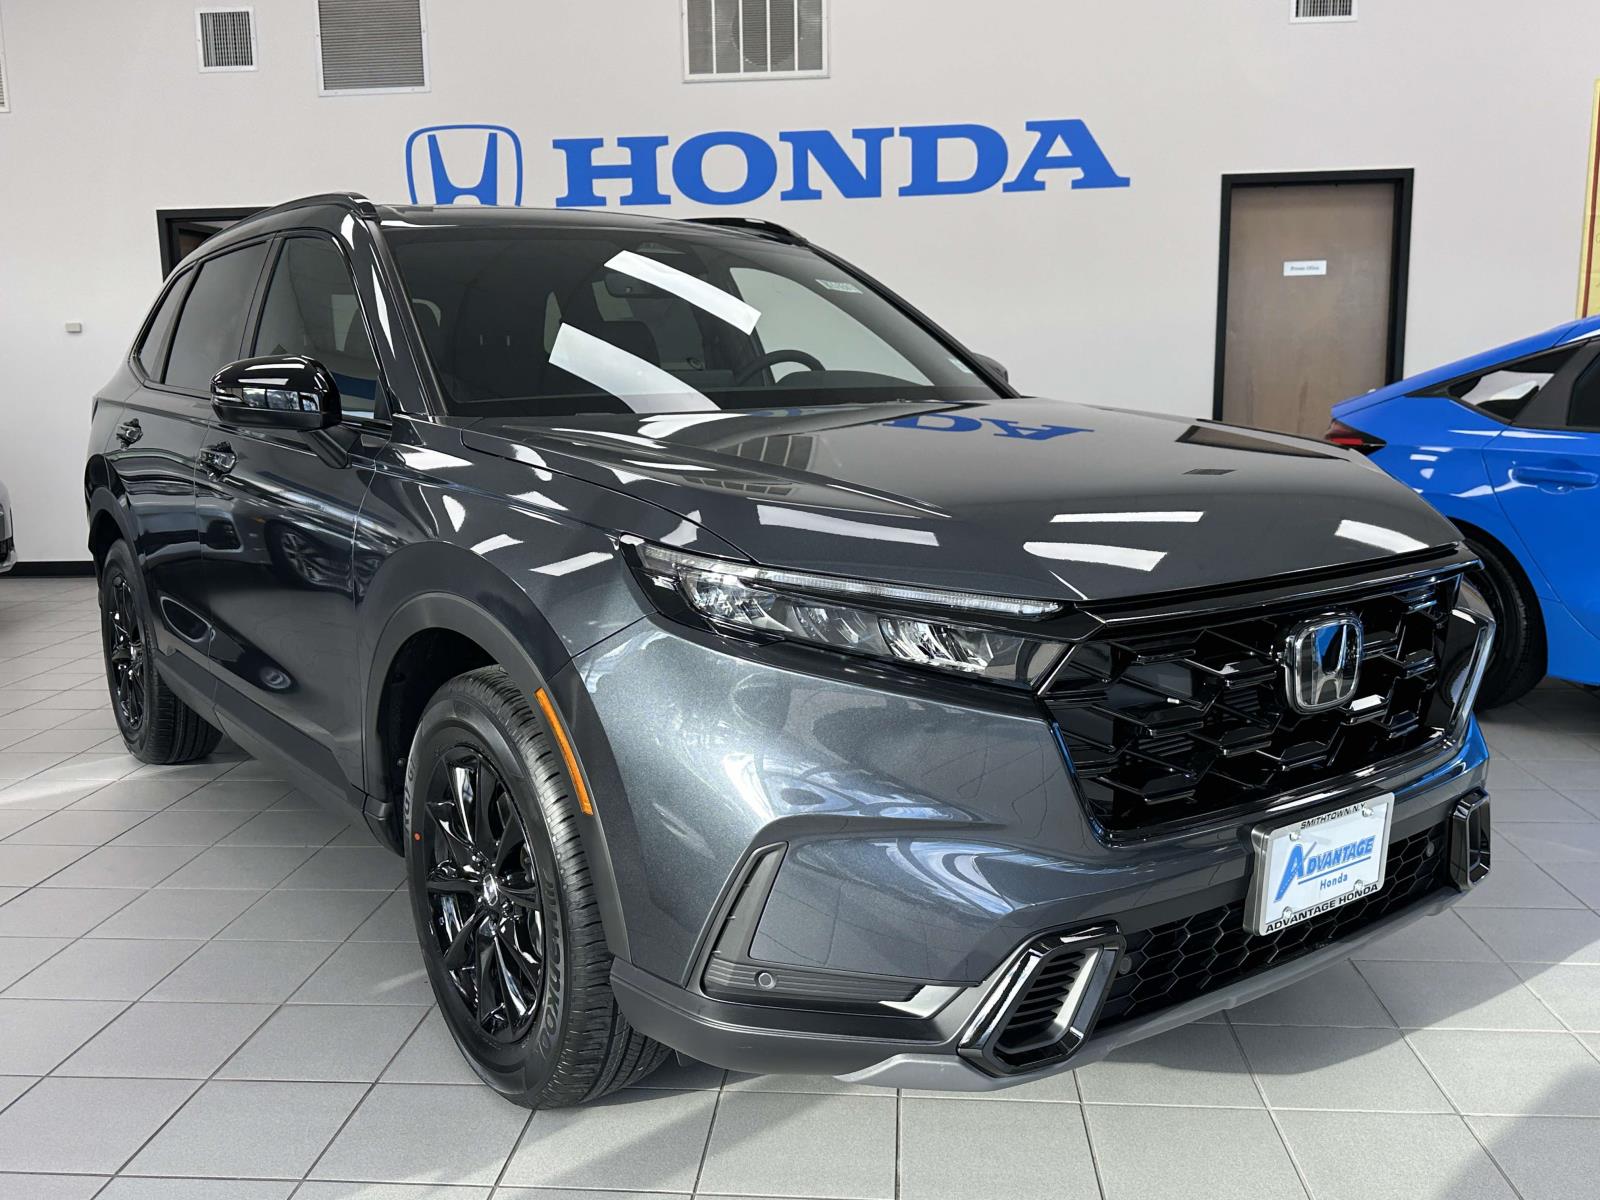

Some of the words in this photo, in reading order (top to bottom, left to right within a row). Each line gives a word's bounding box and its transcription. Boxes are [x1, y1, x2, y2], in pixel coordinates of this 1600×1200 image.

[552, 118, 1131, 208] HONDA
[1274, 835, 1375, 903] ADVANTAGE
[1320, 872, 1348, 890] Honda
[1265, 901, 1336, 933] ADVANTAGE
[1338, 883, 1378, 904] HONDA
